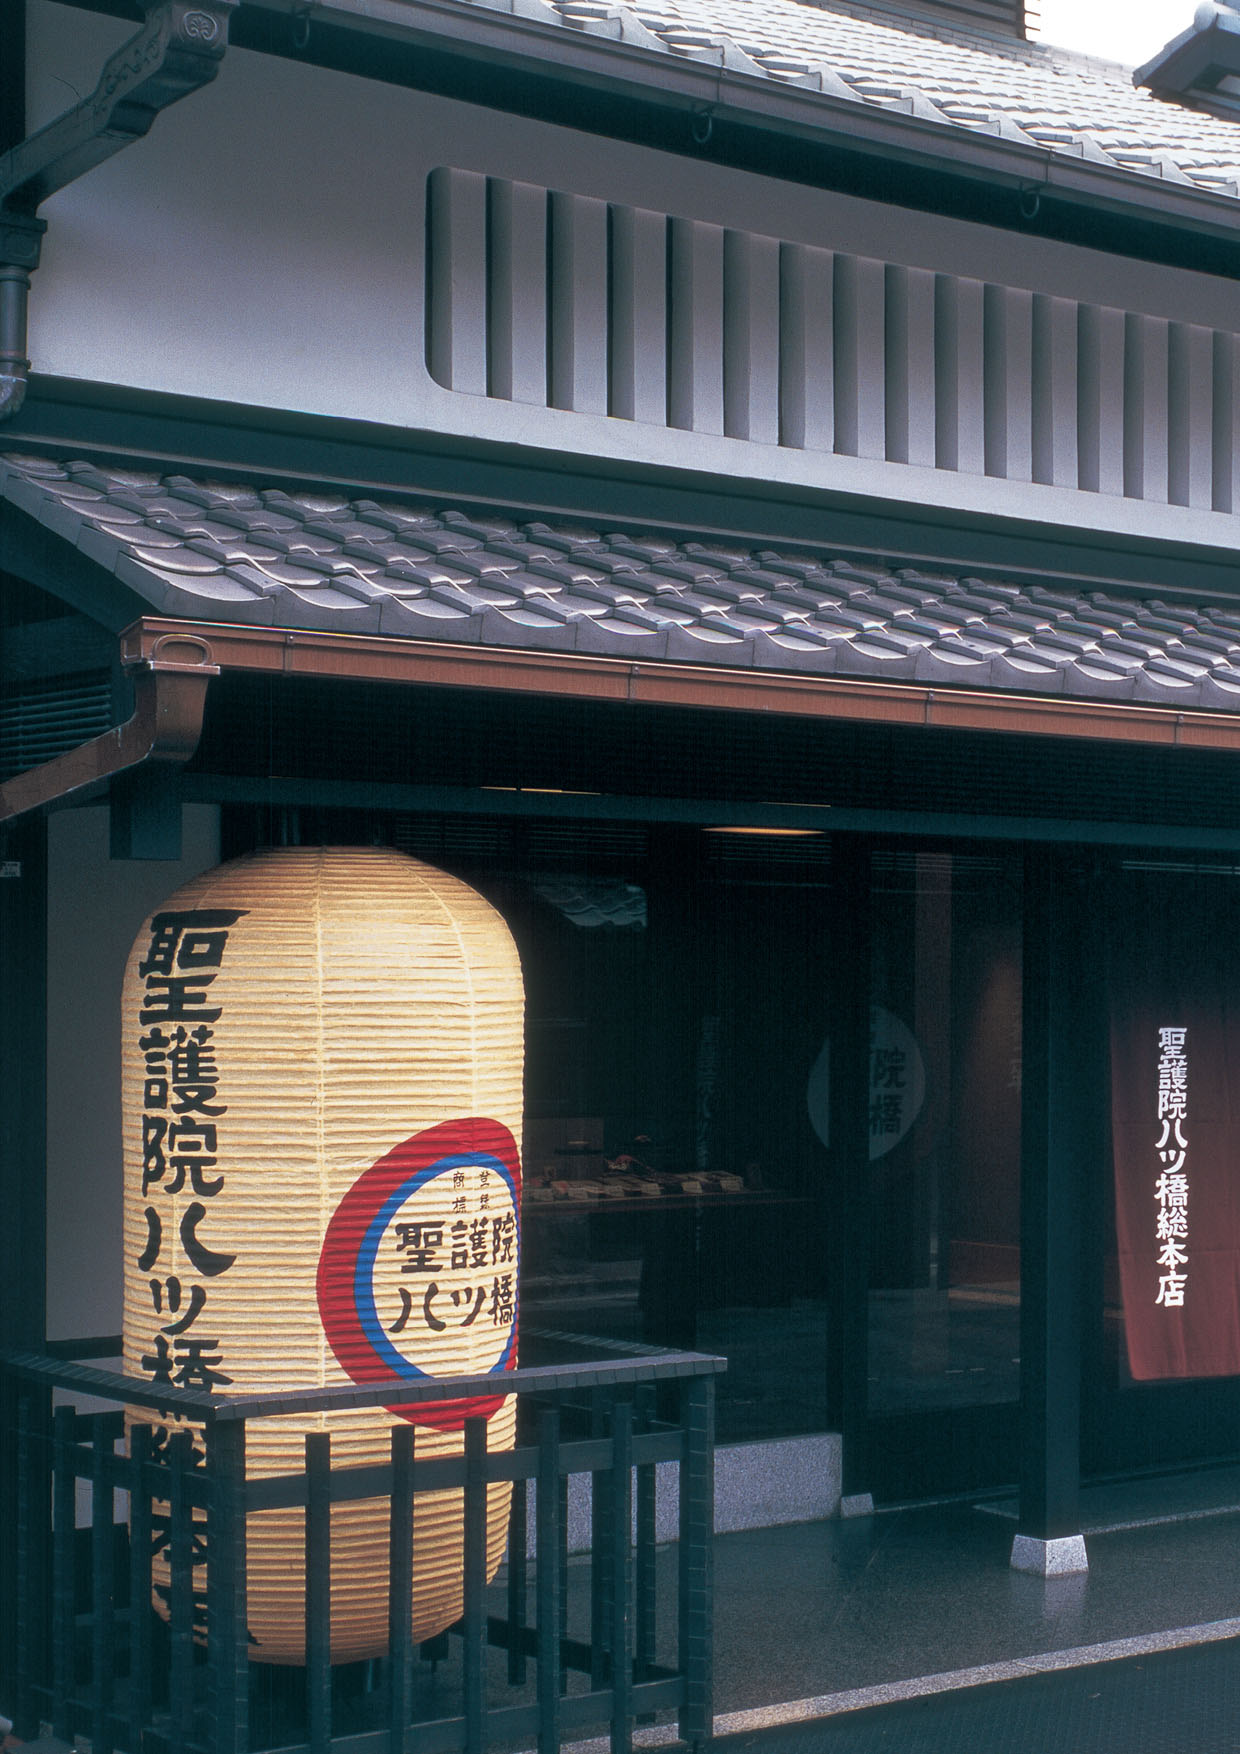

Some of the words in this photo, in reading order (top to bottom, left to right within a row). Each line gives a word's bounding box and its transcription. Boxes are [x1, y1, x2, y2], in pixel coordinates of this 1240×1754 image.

[395, 1211, 516, 1274] 聖護院
[1154, 1027, 1190, 1308] 聖護院八ツ橋総本店
